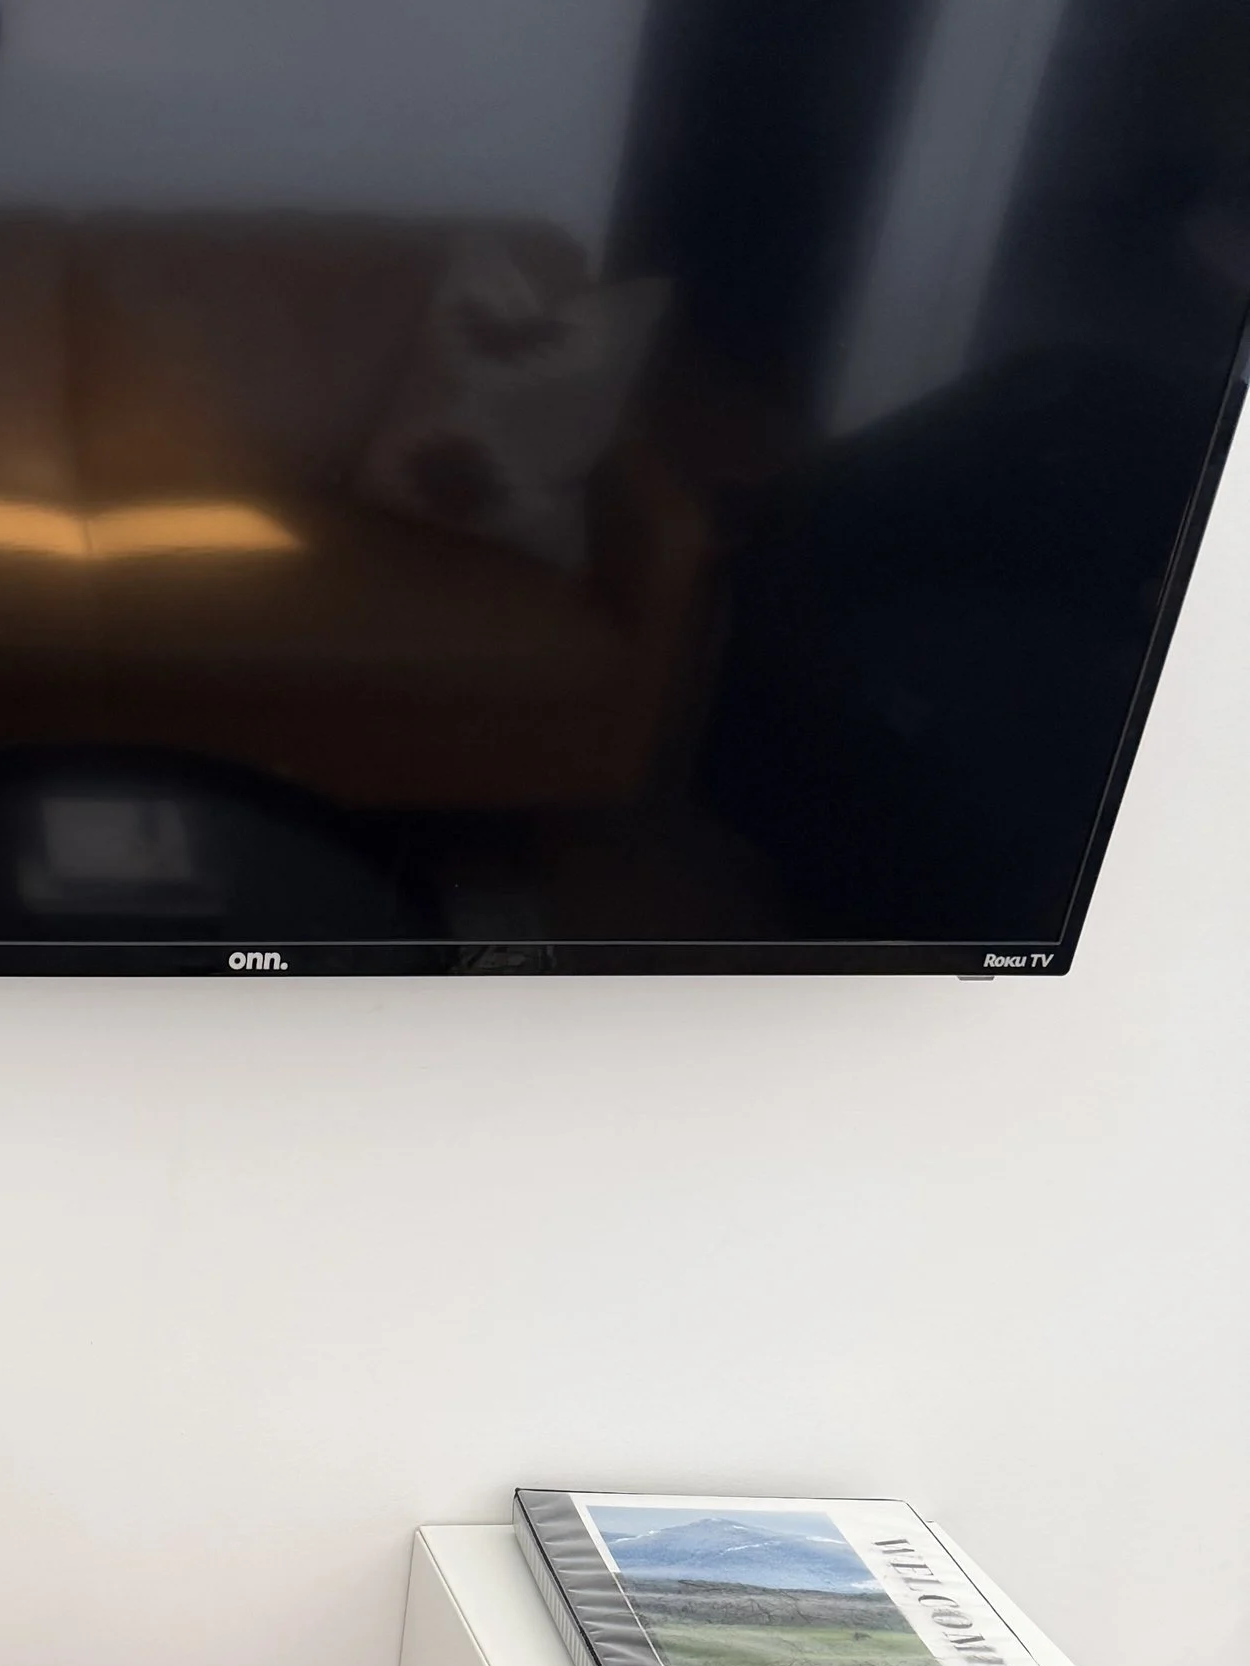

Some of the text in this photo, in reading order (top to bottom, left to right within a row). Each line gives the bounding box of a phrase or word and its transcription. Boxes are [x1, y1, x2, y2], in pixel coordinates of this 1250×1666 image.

[229, 952, 288, 970] onn.
[983, 953, 1054, 968] Roku TV
